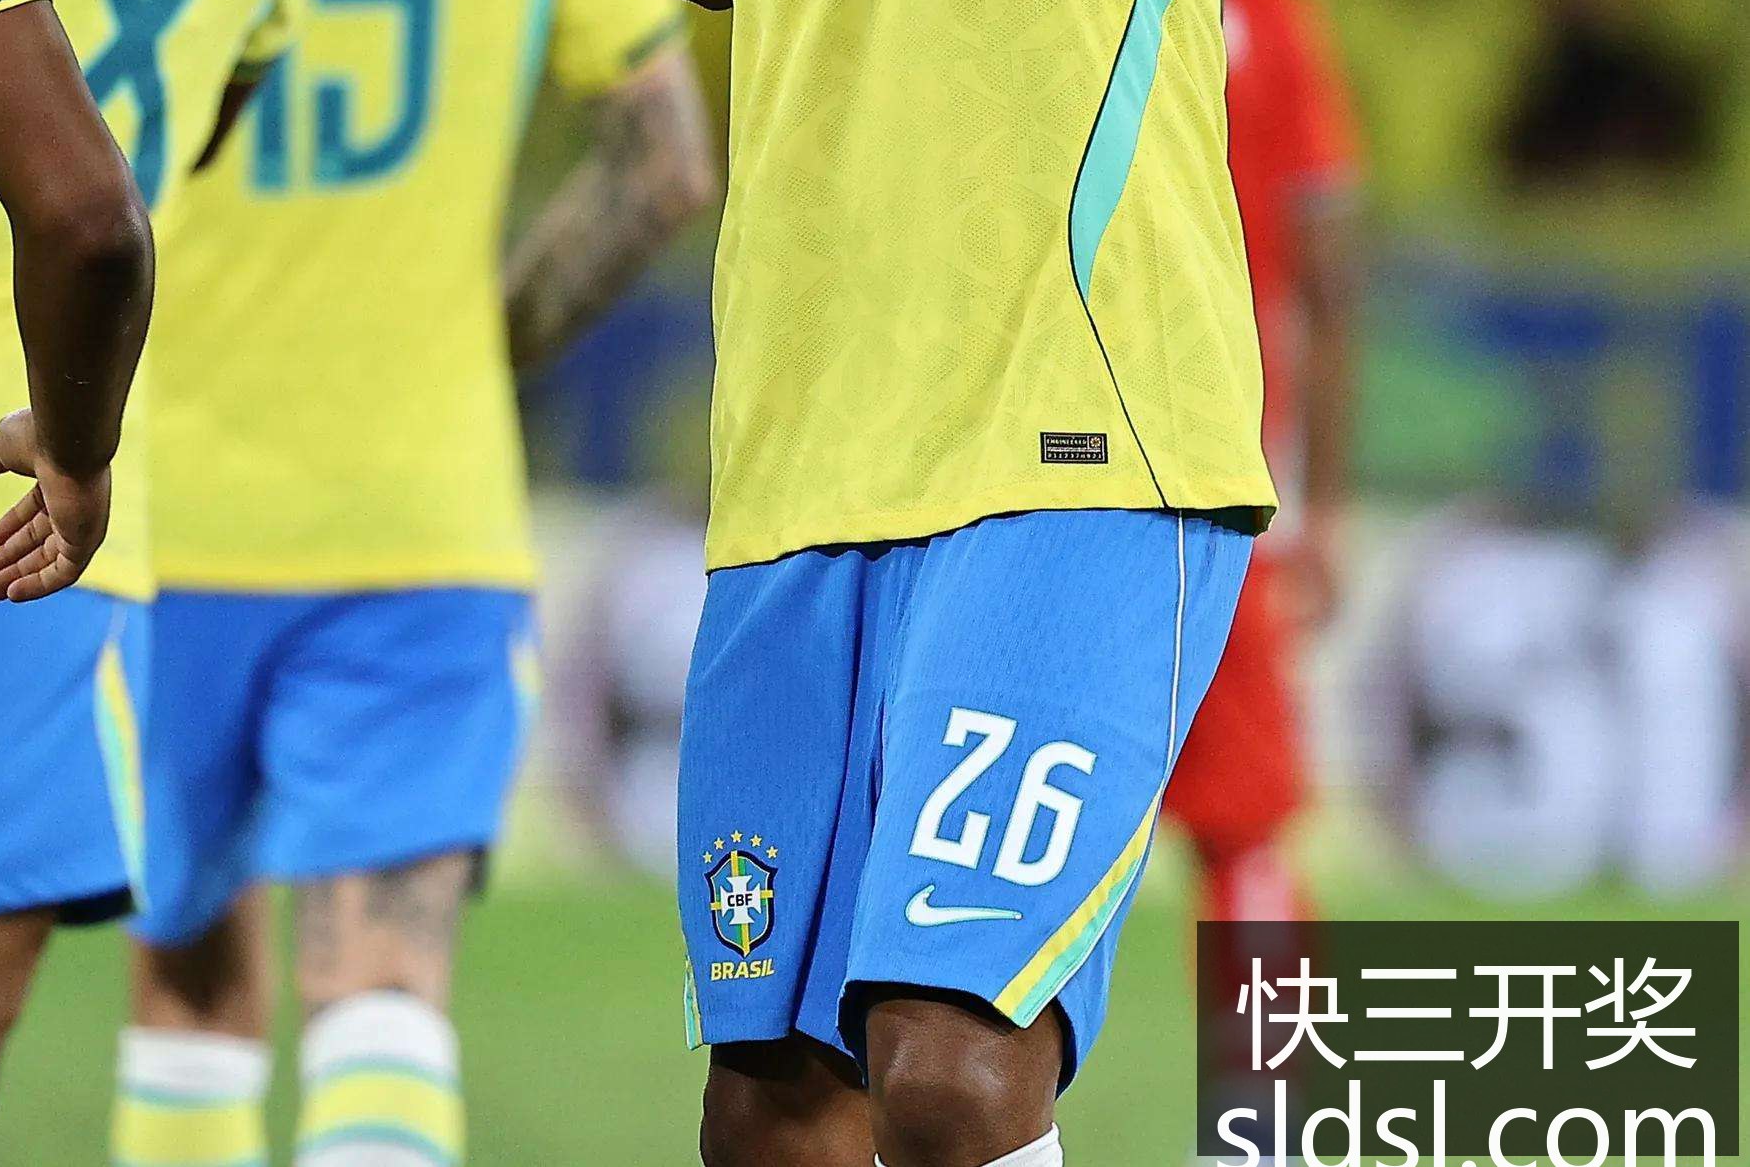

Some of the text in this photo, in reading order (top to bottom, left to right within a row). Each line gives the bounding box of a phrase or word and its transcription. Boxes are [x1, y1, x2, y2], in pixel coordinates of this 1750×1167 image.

[907, 704, 1098, 888] 26
[726, 892, 753, 908] CBF
[710, 957, 776, 981] BRASIL
